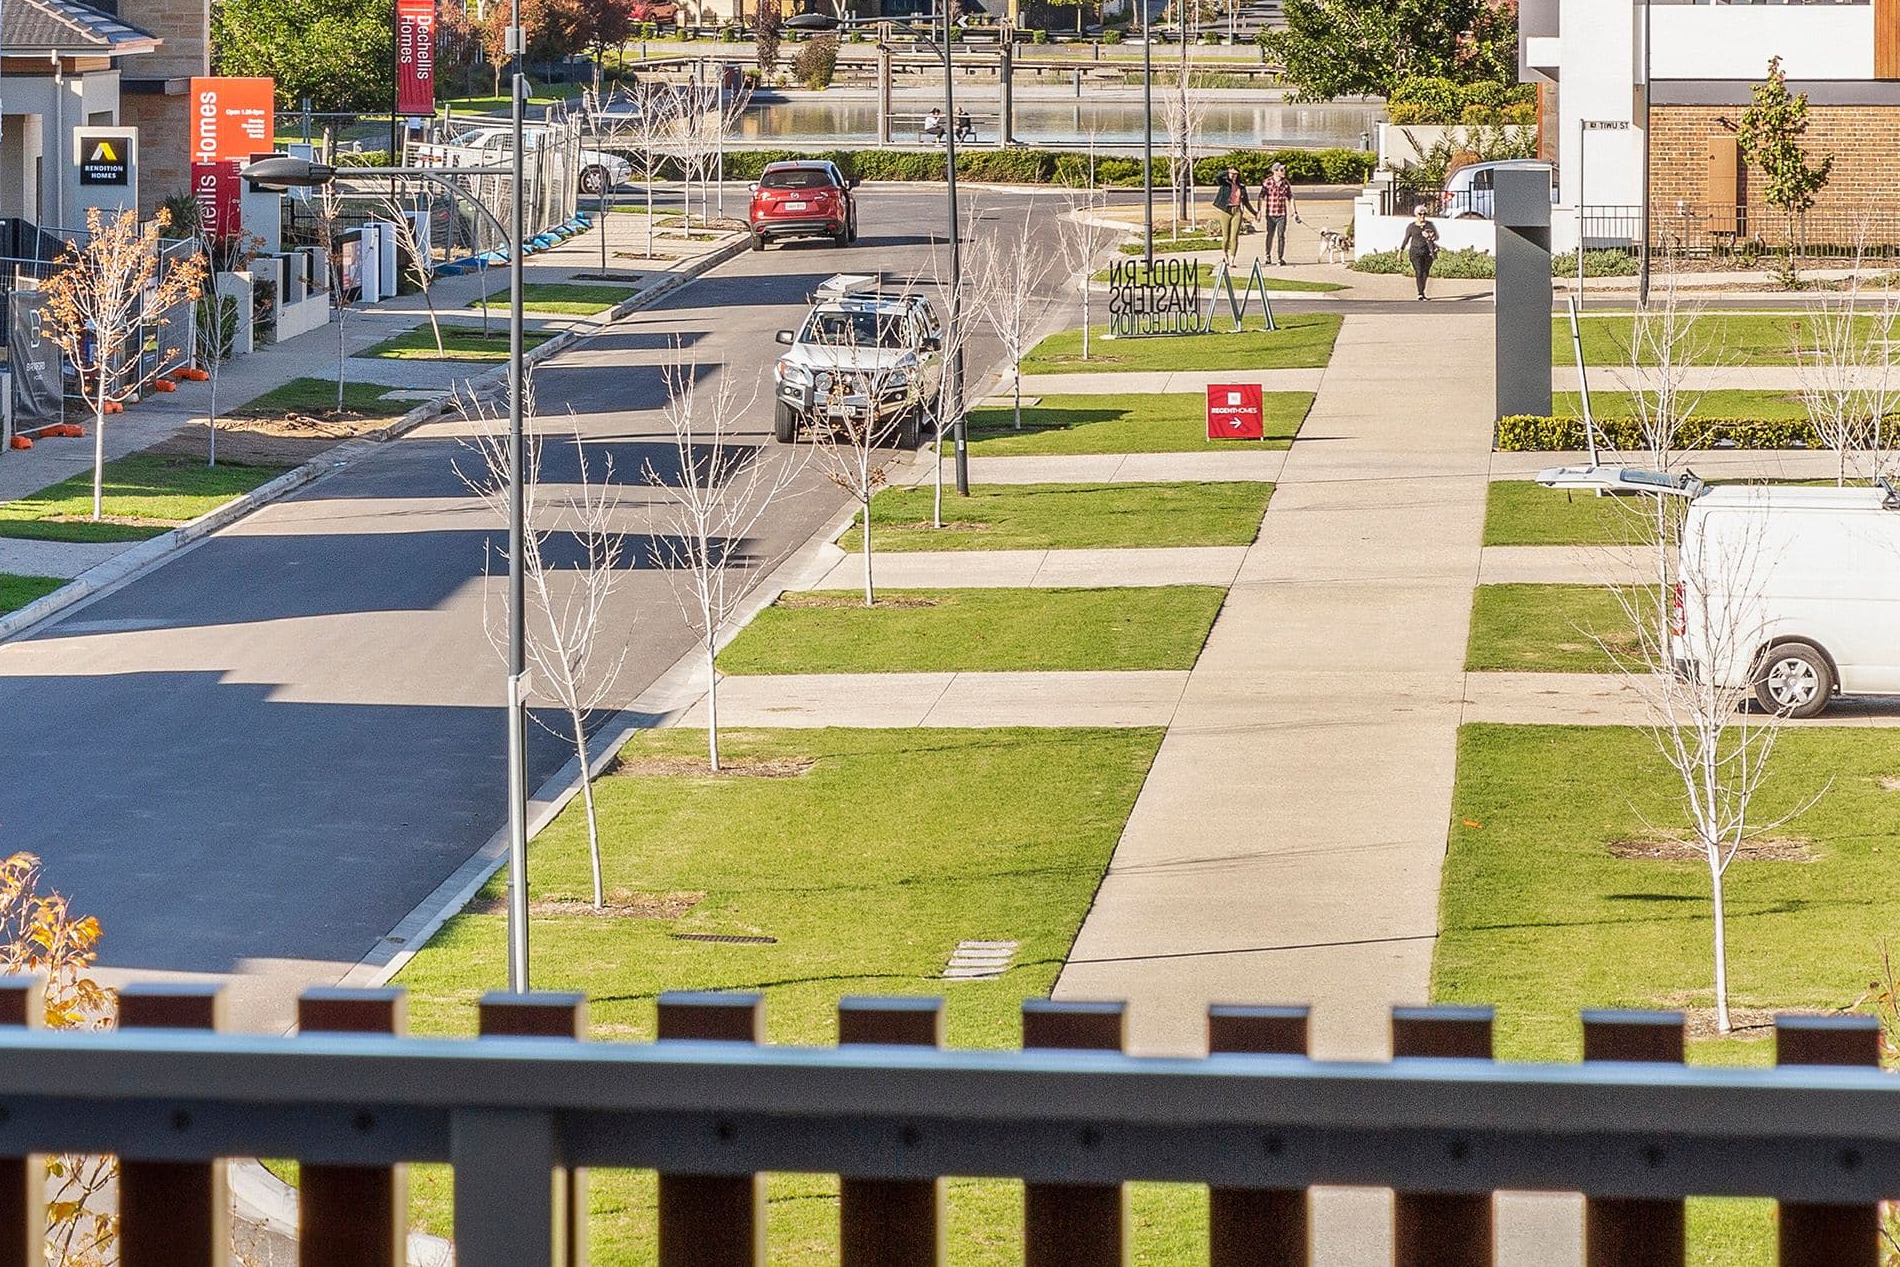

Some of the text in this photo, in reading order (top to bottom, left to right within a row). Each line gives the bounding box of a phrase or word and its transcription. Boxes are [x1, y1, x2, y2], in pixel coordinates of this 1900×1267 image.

[401, 15, 415, 63] Homes
[417, 15, 432, 79] Dechellis
[196, 91, 217, 166] Homes
